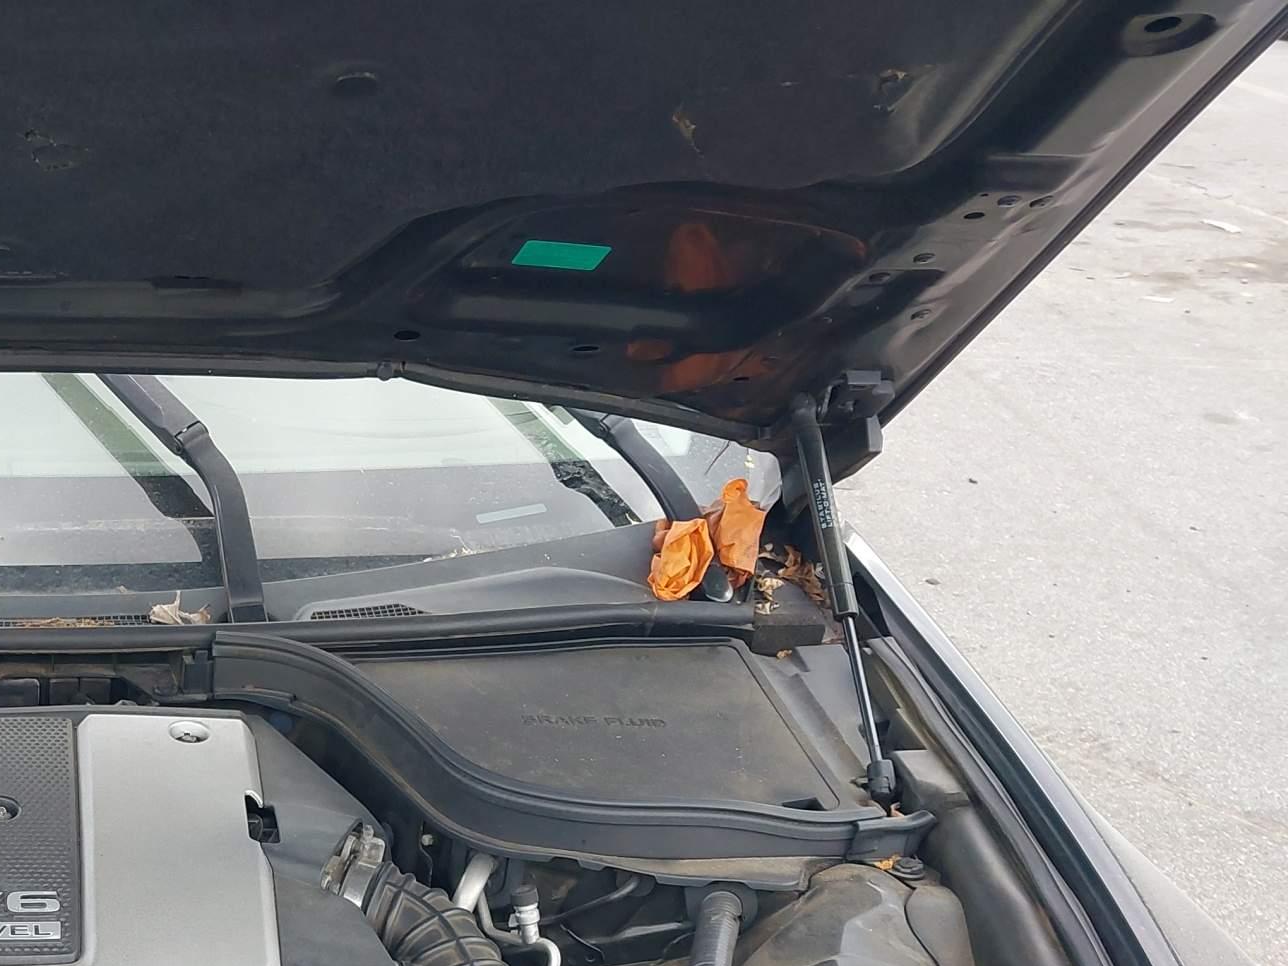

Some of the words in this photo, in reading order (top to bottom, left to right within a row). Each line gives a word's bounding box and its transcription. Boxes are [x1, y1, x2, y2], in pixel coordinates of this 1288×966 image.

[813, 482, 827, 529] STABILUS
[520, 714, 597, 726] BRAKE
[603, 716, 667, 728] FLUID
